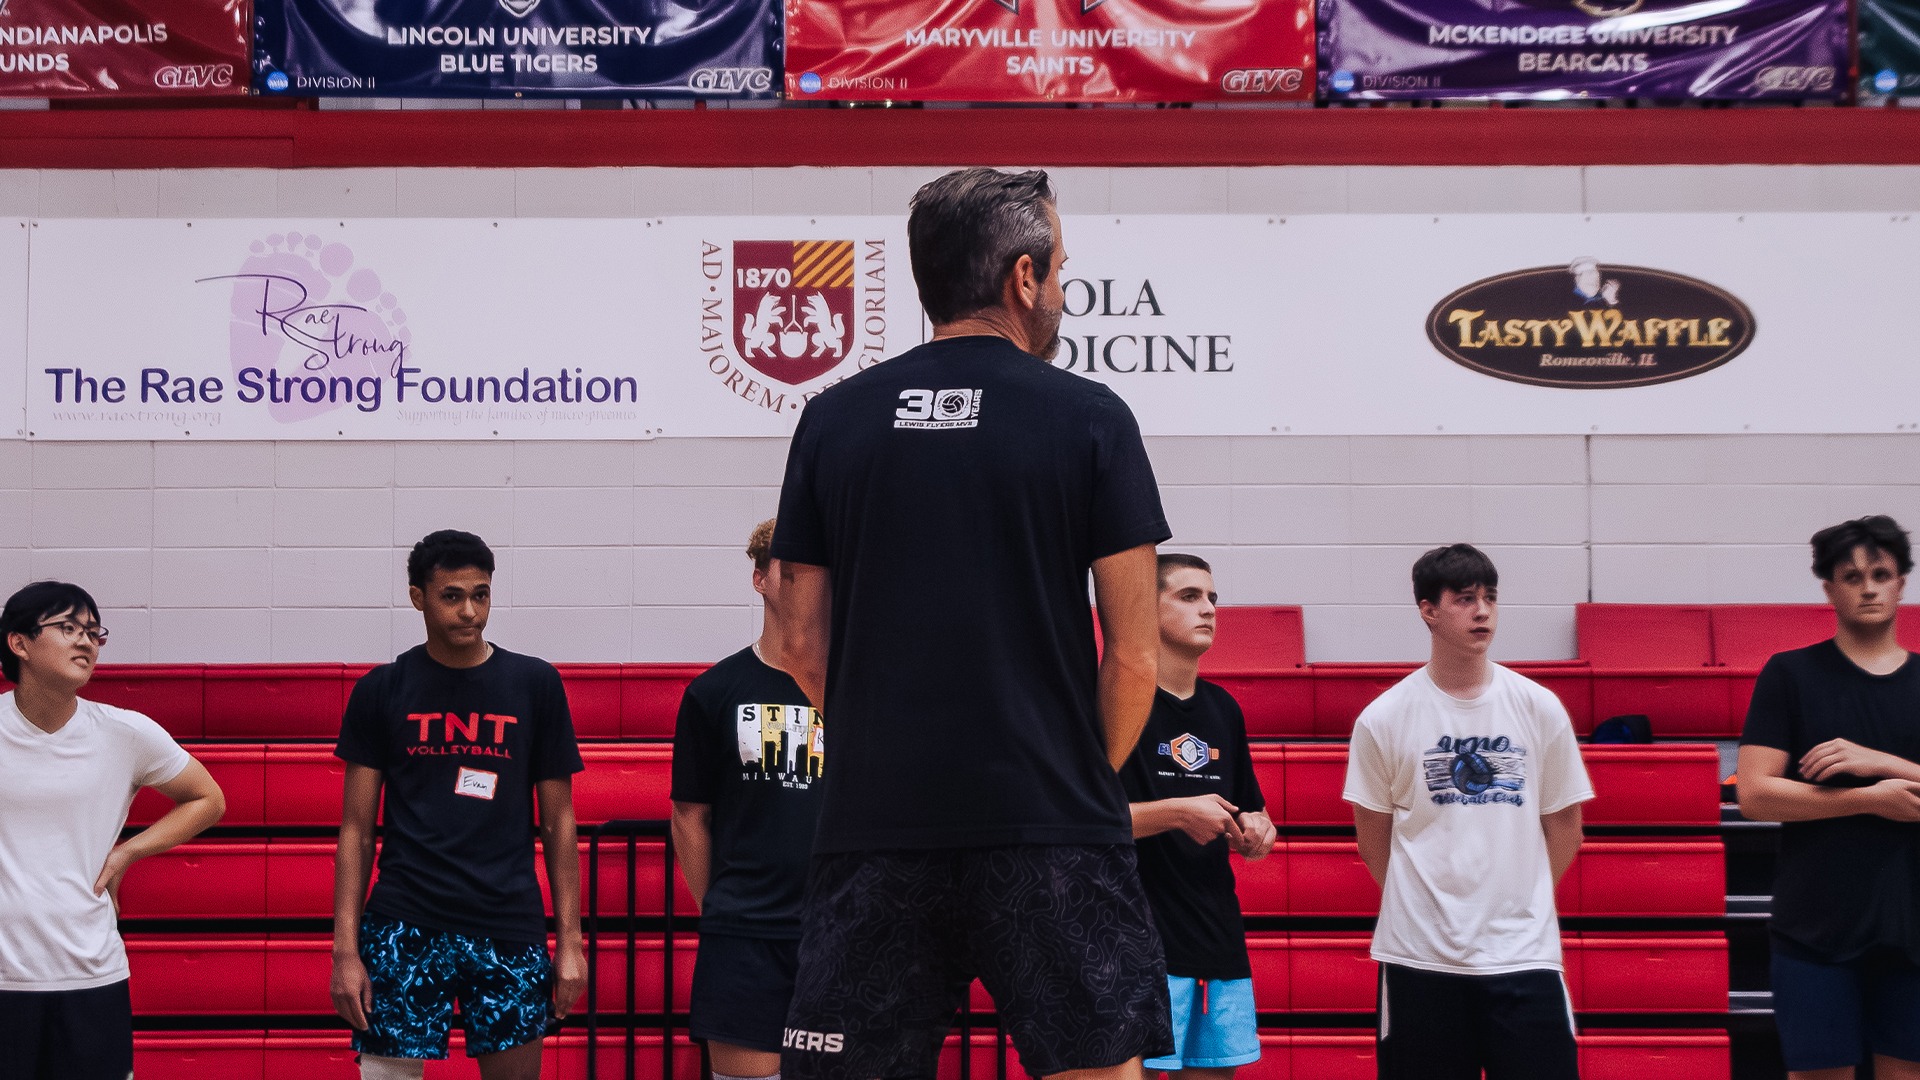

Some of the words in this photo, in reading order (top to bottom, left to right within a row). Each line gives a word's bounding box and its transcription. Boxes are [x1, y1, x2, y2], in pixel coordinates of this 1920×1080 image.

[387, 27, 494, 45] LINCOLN
[503, 26, 652, 45] UNIVERSITY
[905, 28, 1042, 47] MARYVILLE
[1052, 28, 1197, 48] UNIVERSITY
[1428, 25, 1586, 45] MCKENDREE
[1591, 25, 1738, 45] UNIVERSITY
[440, 54, 504, 73] BLUE
[511, 54, 598, 73] TIGERS
[1006, 55, 1094, 75] SAINTS
[1518, 52, 1650, 73] BEARCATS
[154, 65, 233, 88] GLVC
[297, 76, 362, 89] DIVISION
[368, 76, 376, 89] II
[688, 67, 772, 93] GLVC
[829, 77, 895, 89] DIVISION
[900, 77, 908, 89] II
[1221, 68, 1303, 93] GLVC
[1363, 75, 1428, 88] DIVISION
[701, 239, 723, 280] AD
[736, 268, 792, 288] 1870
[195, 273, 335, 341] Rae
[281, 304, 409, 379] Strong
[700, 297, 786, 414] MAJOREM
[1637, 353, 1658, 367] IL
[45, 367, 126, 403] The
[141, 367, 224, 403] Rae
[237, 367, 382, 412] Strong
[397, 367, 638, 403] Foundation
[895, 389, 973, 420] 30
[971, 388, 983, 419] YEARS
[926, 420, 955, 428] FLYERS
[407, 712, 518, 743] TNT
[406, 745, 512, 759] VOLLEYBALL
[463, 774, 488, 790] Evan
[782, 1027, 844, 1053] LYERS
